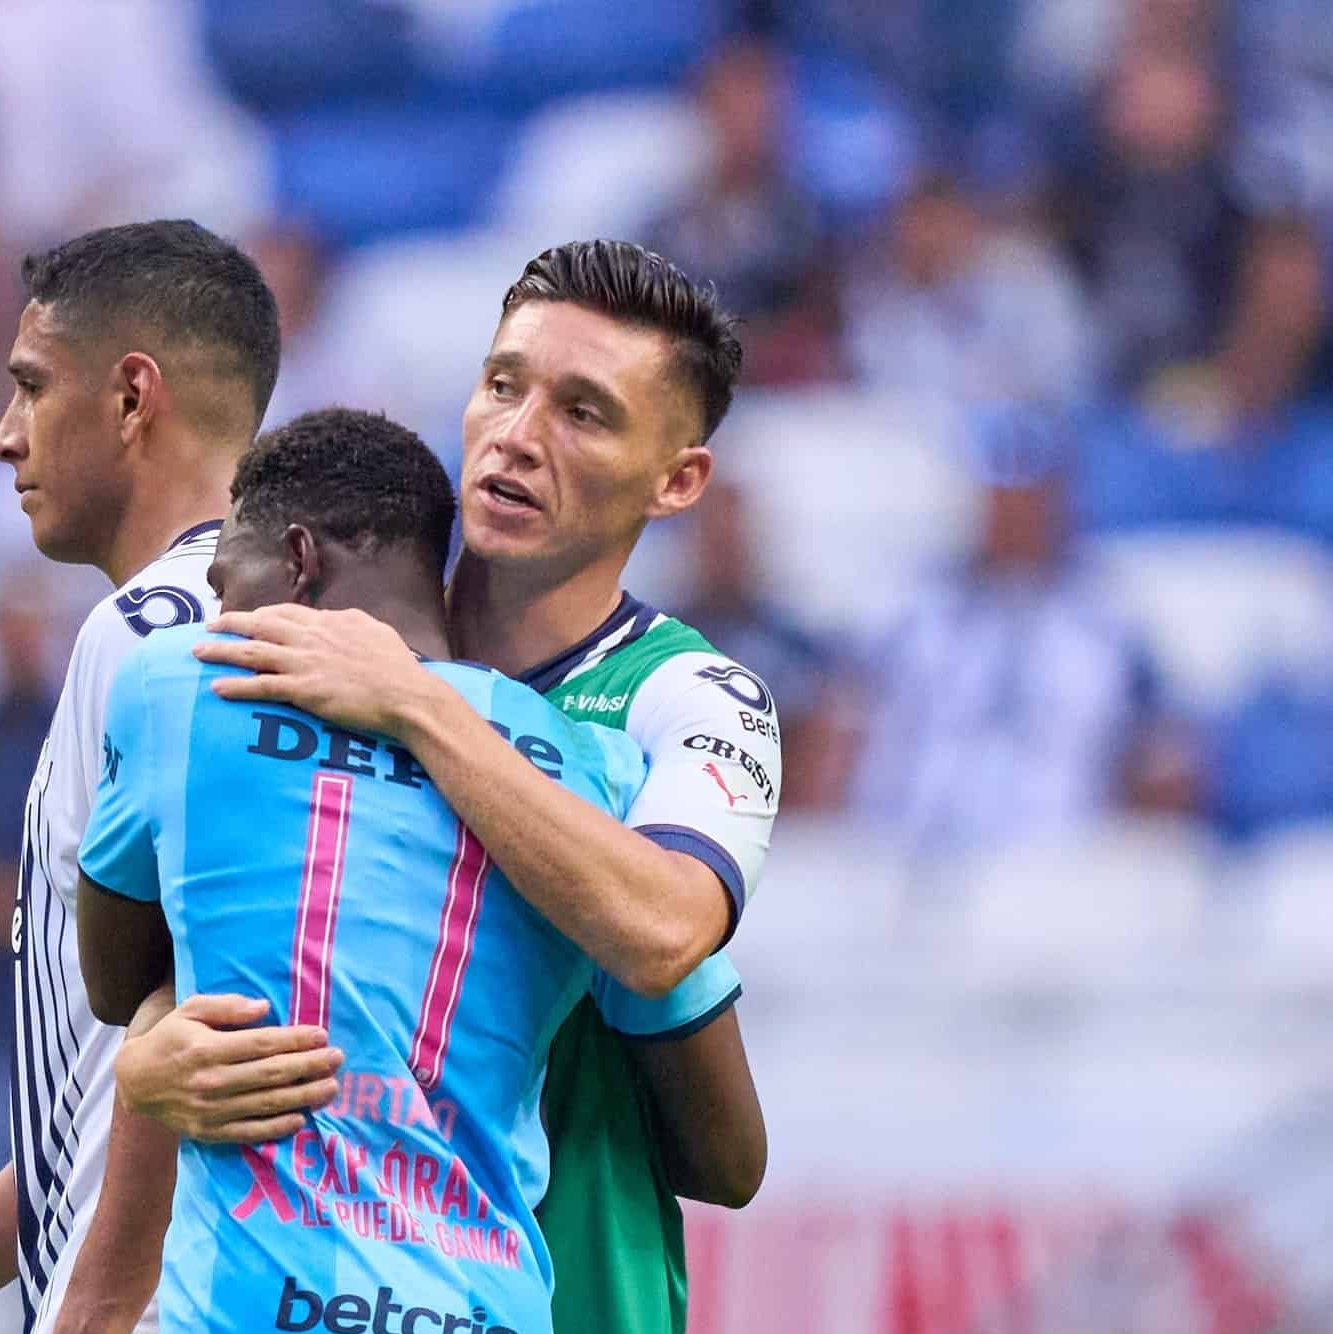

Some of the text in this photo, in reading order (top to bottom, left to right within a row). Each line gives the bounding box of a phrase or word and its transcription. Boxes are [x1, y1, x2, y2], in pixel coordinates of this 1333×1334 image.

[299, 1190, 521, 1270] LE PUEDE GANAR
